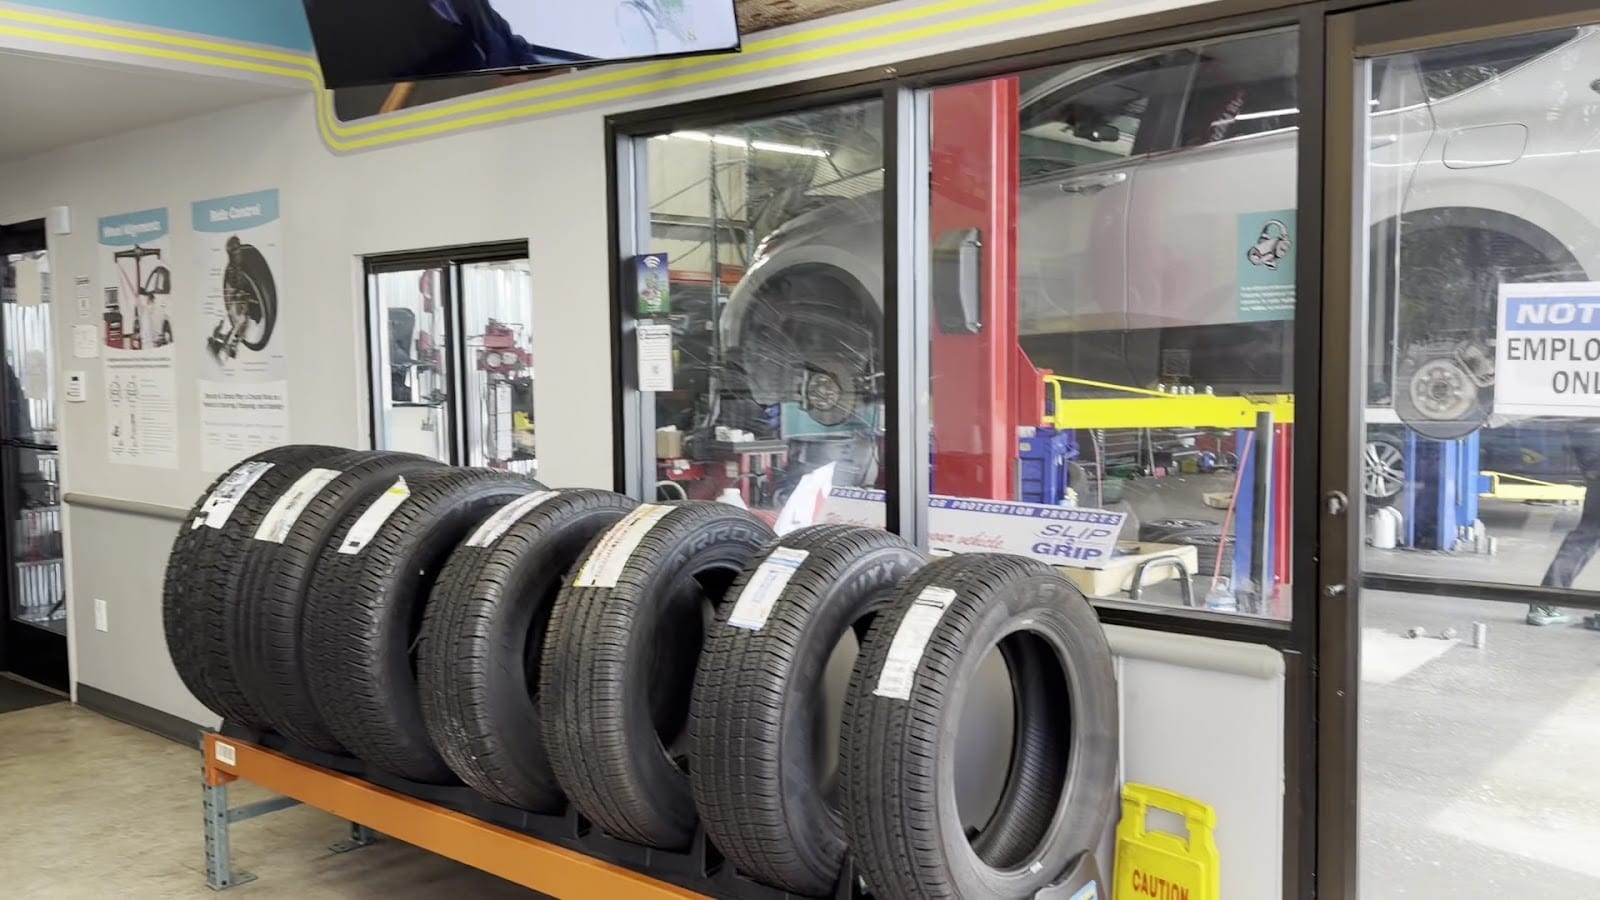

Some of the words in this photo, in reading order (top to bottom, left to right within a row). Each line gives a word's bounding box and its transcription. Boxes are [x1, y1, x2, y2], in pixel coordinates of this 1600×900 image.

[1515, 303, 1600, 325] NOT
[1507, 337, 1600, 361] EMPLO
[951, 500, 1035, 516] PROTECTION
[1040, 509, 1121, 525] PRODUCTS
[1041, 524, 1112, 540] SLIP
[1031, 542, 1103, 561] GRIP
[1132, 868, 1189, 900] CAUTION
